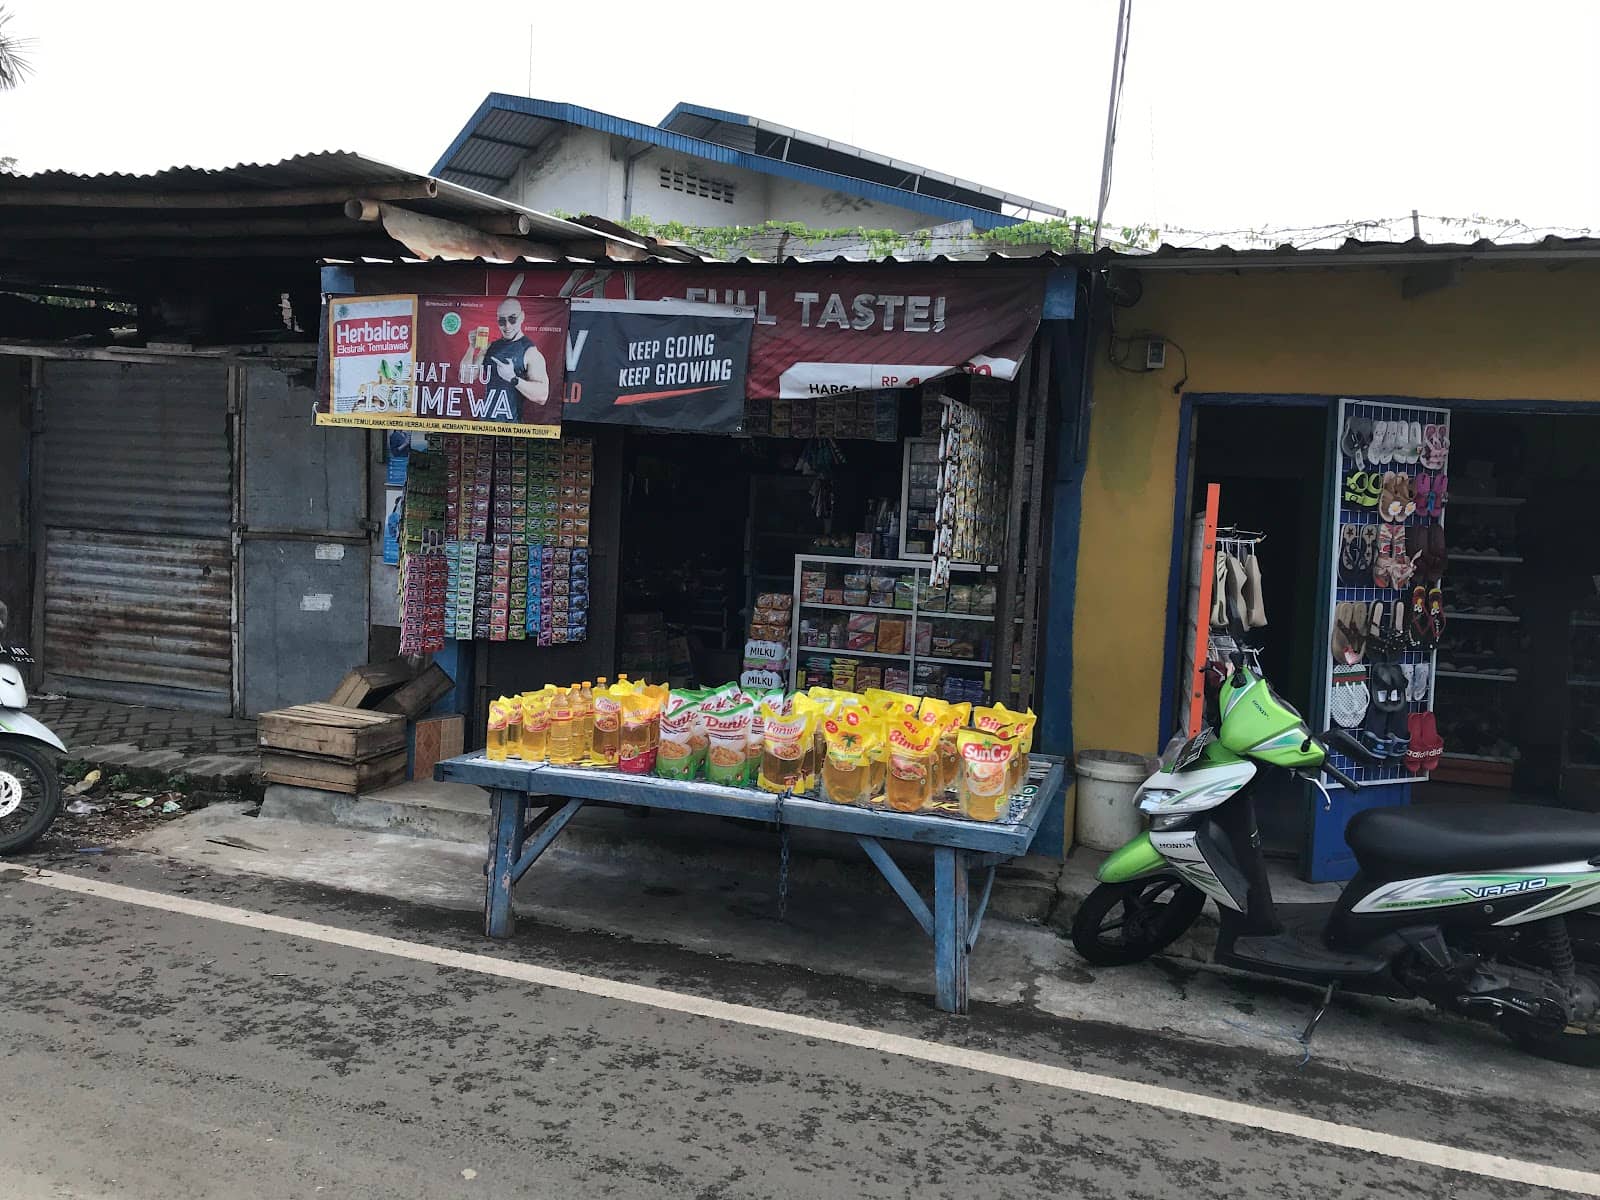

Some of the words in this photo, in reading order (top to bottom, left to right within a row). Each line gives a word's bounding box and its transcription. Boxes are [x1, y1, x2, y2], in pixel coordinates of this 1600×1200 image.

[794, 292, 946, 332] TASTE!
[336, 320, 409, 343] Herbalice
[337, 343, 365, 354] Ekstrak
[368, 341, 408, 351] Temulawak
[628, 341, 659, 362] KEEP
[665, 333, 715, 359] GOING
[391, 361, 450, 383] SEHAT
[460, 363, 491, 384] ITU
[619, 368, 650, 388] KEEP
[655, 358, 732, 386] GROWING
[882, 376, 898, 387] RP
[365, 383, 513, 420] ISTIMEWA
[353, 418, 386, 427] TEMULAWAK
[472, 425, 497, 433] MENJAGA
[750, 647, 776, 658] MILKU
[747, 676, 773, 687] MILKU
[964, 744, 1009, 762] SunCo
[1463, 877, 1547, 899] VARIO
